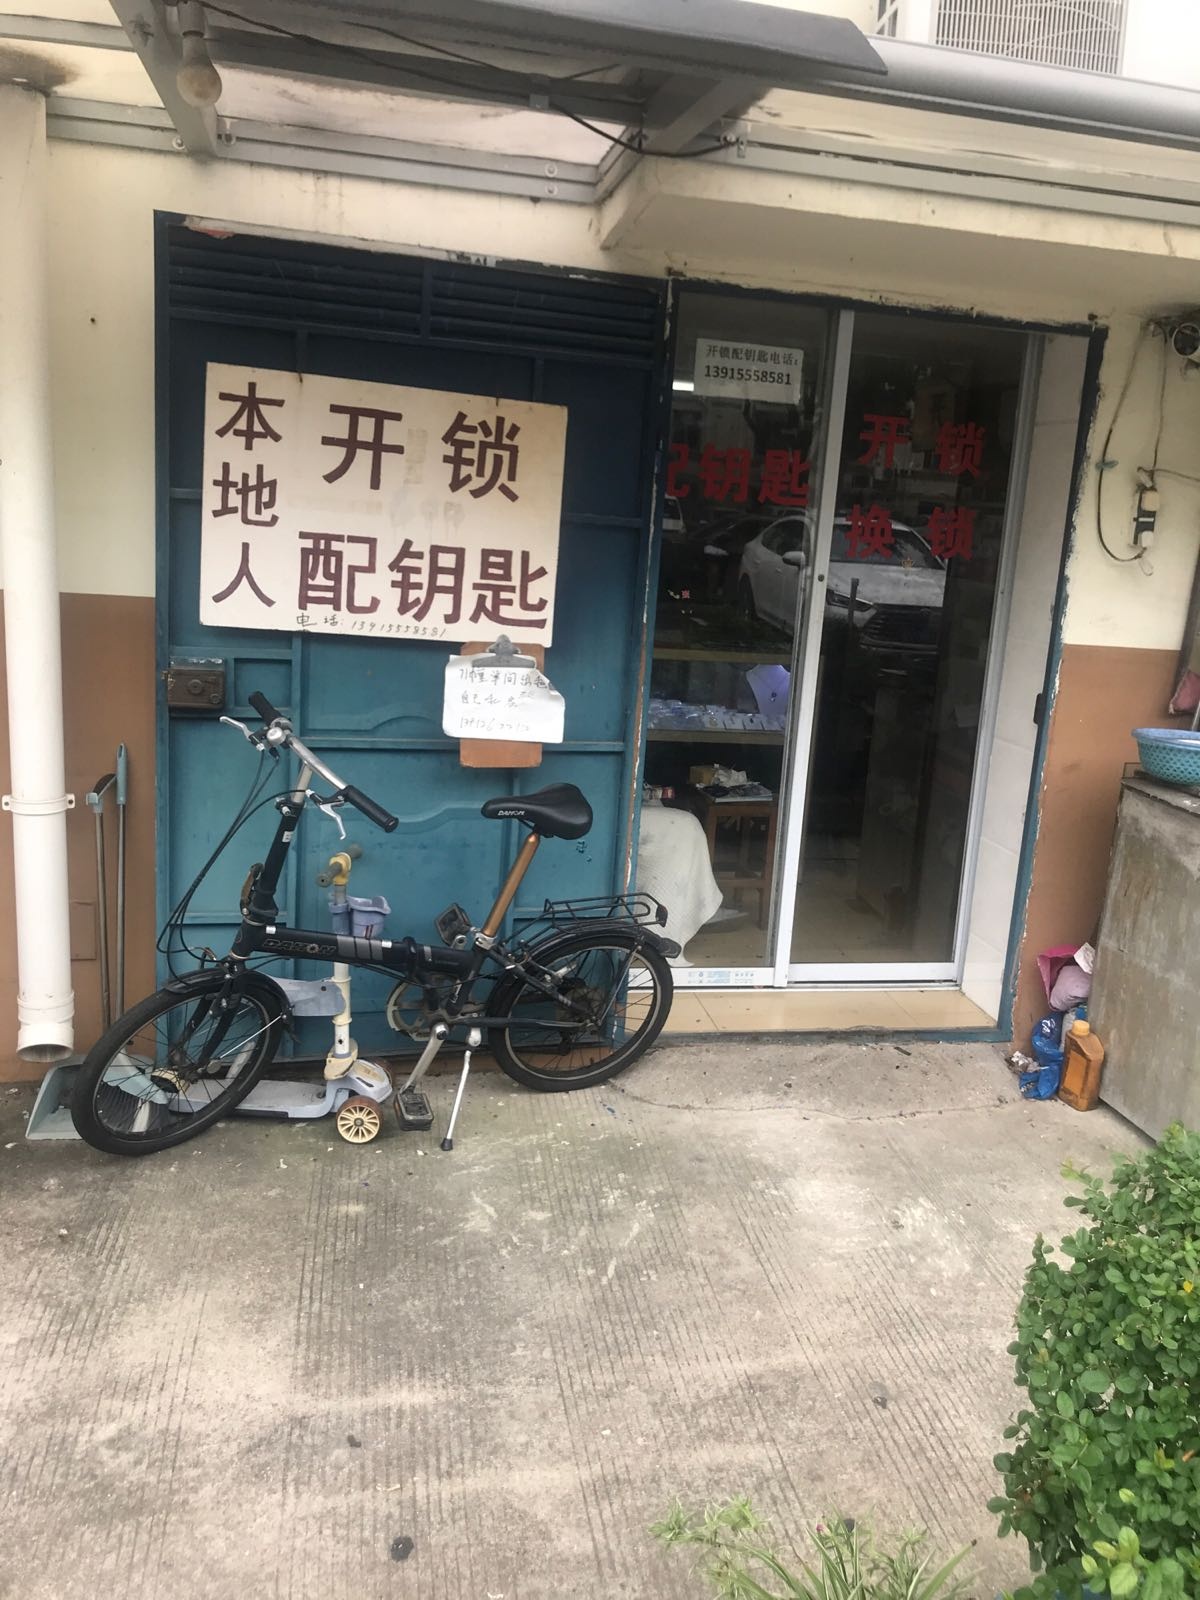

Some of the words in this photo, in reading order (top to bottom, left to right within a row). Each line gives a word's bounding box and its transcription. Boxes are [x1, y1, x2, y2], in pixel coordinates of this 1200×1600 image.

[704, 364, 792, 386] 13915558581
[320, 403, 521, 503] 开锁
[859, 413, 988, 479] 开锁
[211, 381, 286, 609] 本地人
[844, 504, 979, 561] 换锁
[297, 530, 549, 630] 配钥匙
[351, 620, 448, 639] 13915558581
